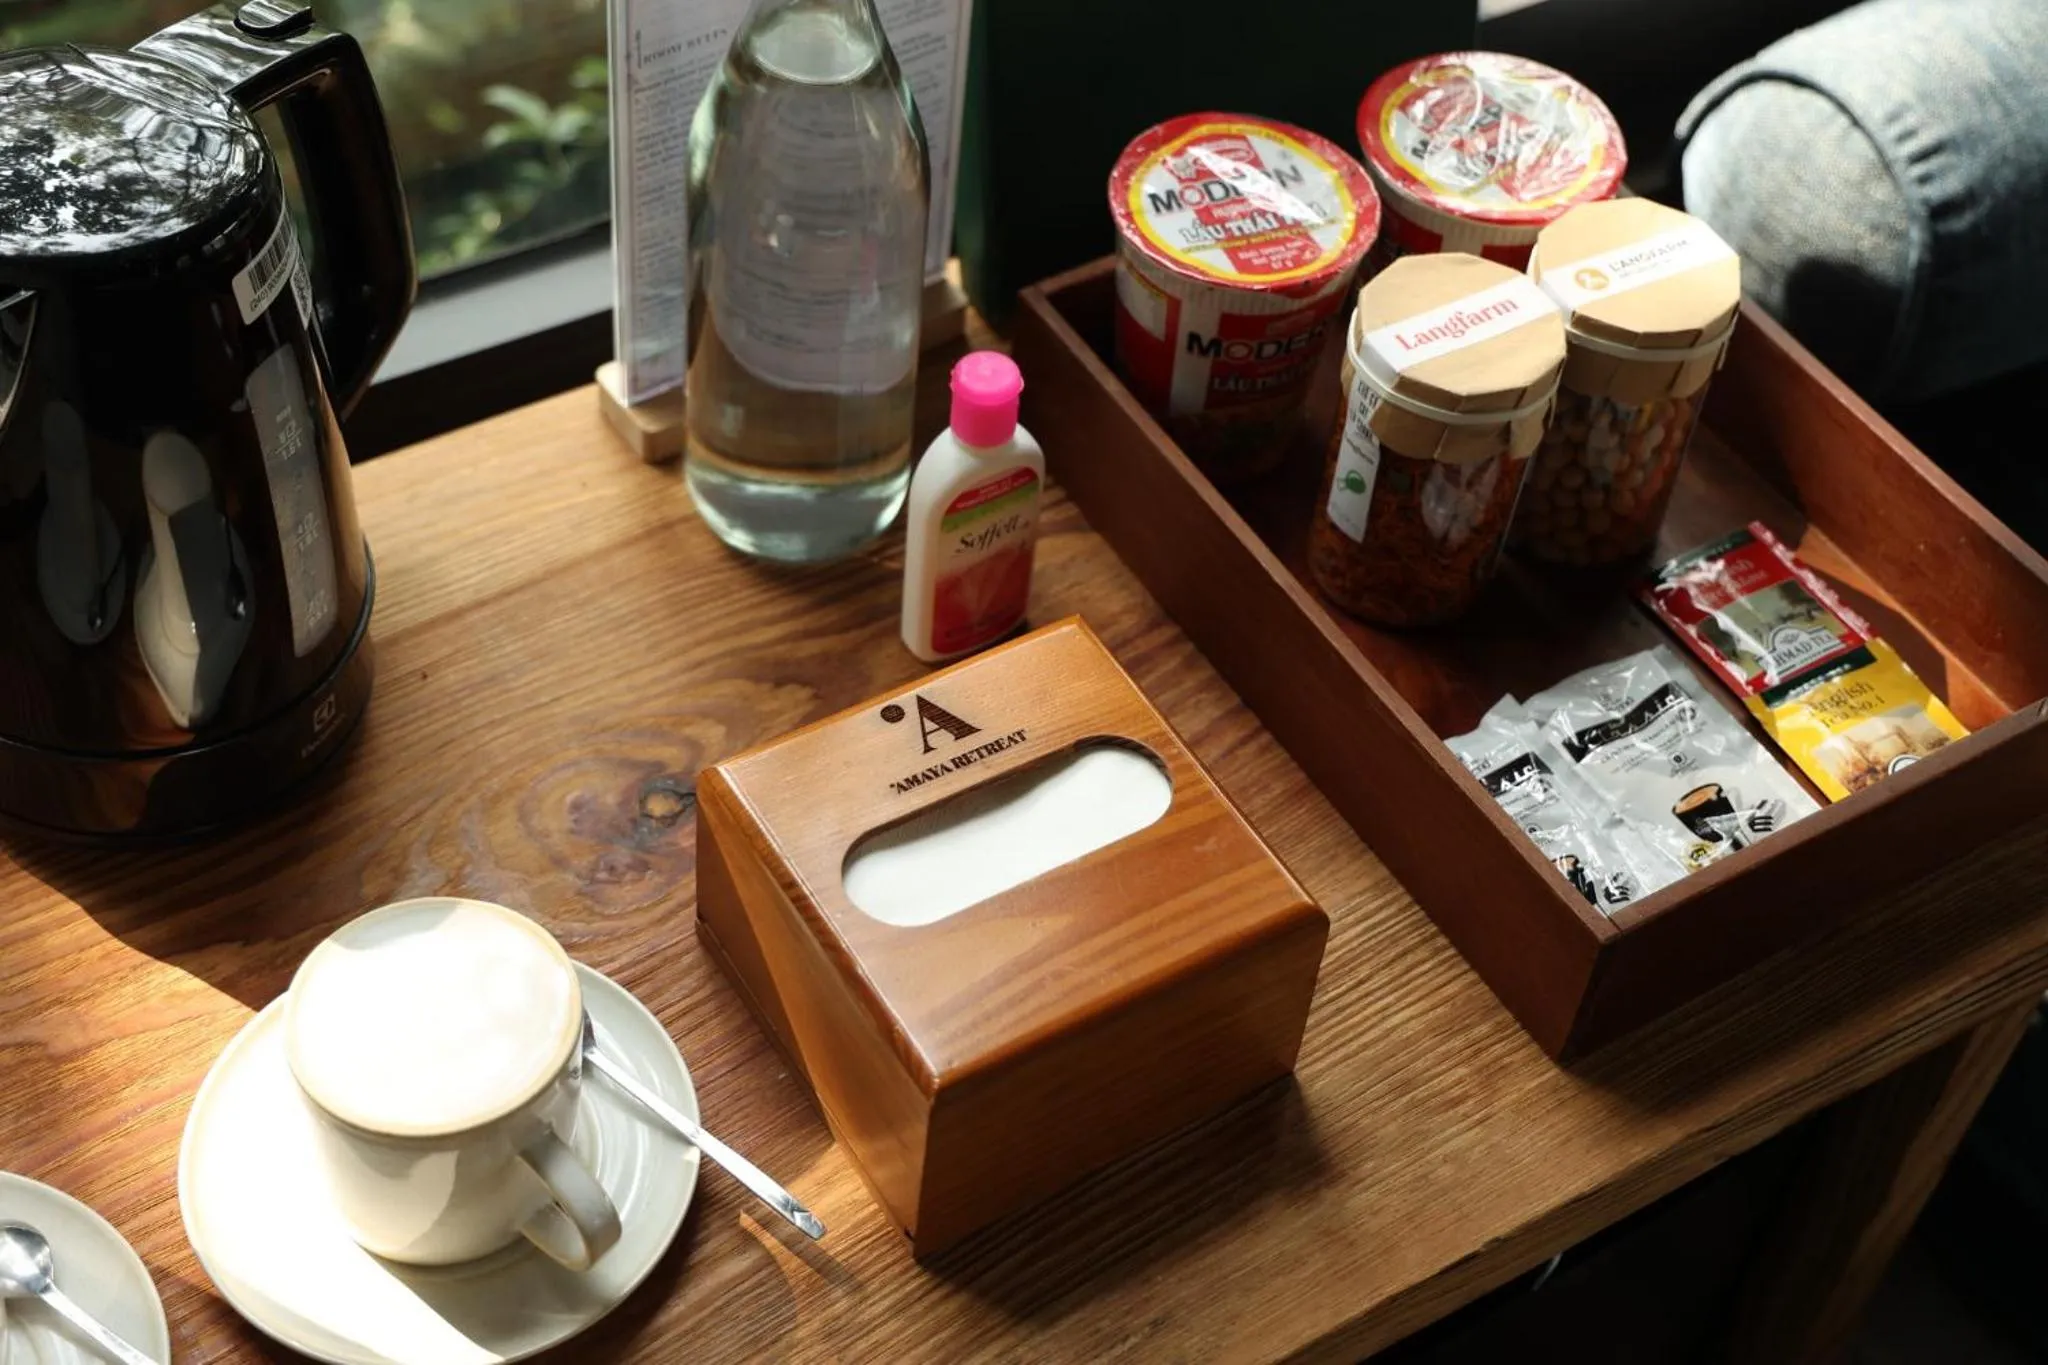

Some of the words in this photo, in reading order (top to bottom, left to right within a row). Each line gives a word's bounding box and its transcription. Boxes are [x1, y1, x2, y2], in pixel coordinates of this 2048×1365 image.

[1148, 164, 1304, 215] MODN
[1186, 324, 1328, 361] MODE
[1394, 296, 1520, 352] Langfarm
[1772, 640, 1813, 668] HMAD
[950, 728, 1028, 770] RETREAT
